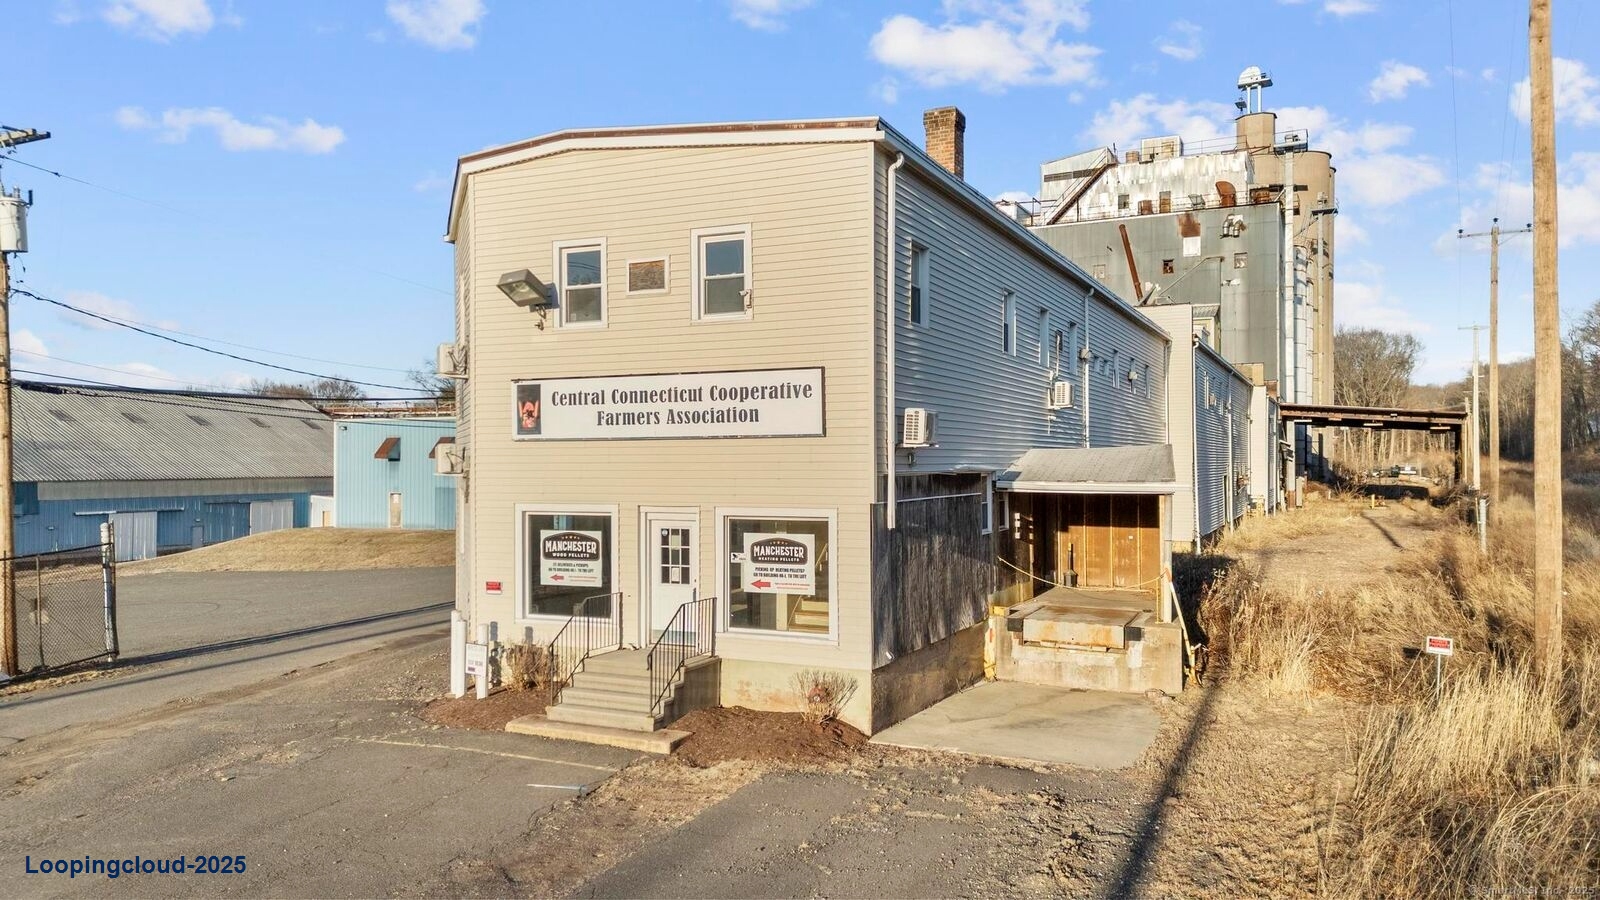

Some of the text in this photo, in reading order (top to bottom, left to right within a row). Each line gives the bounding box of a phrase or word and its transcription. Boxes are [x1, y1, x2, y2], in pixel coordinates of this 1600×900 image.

[552, 382, 812, 406] Central Connecticut Cooperative
[597, 407, 759, 426] Farmers Association
[545, 540, 596, 554] MANCHESTER
[753, 546, 804, 558] MANCHESTER
